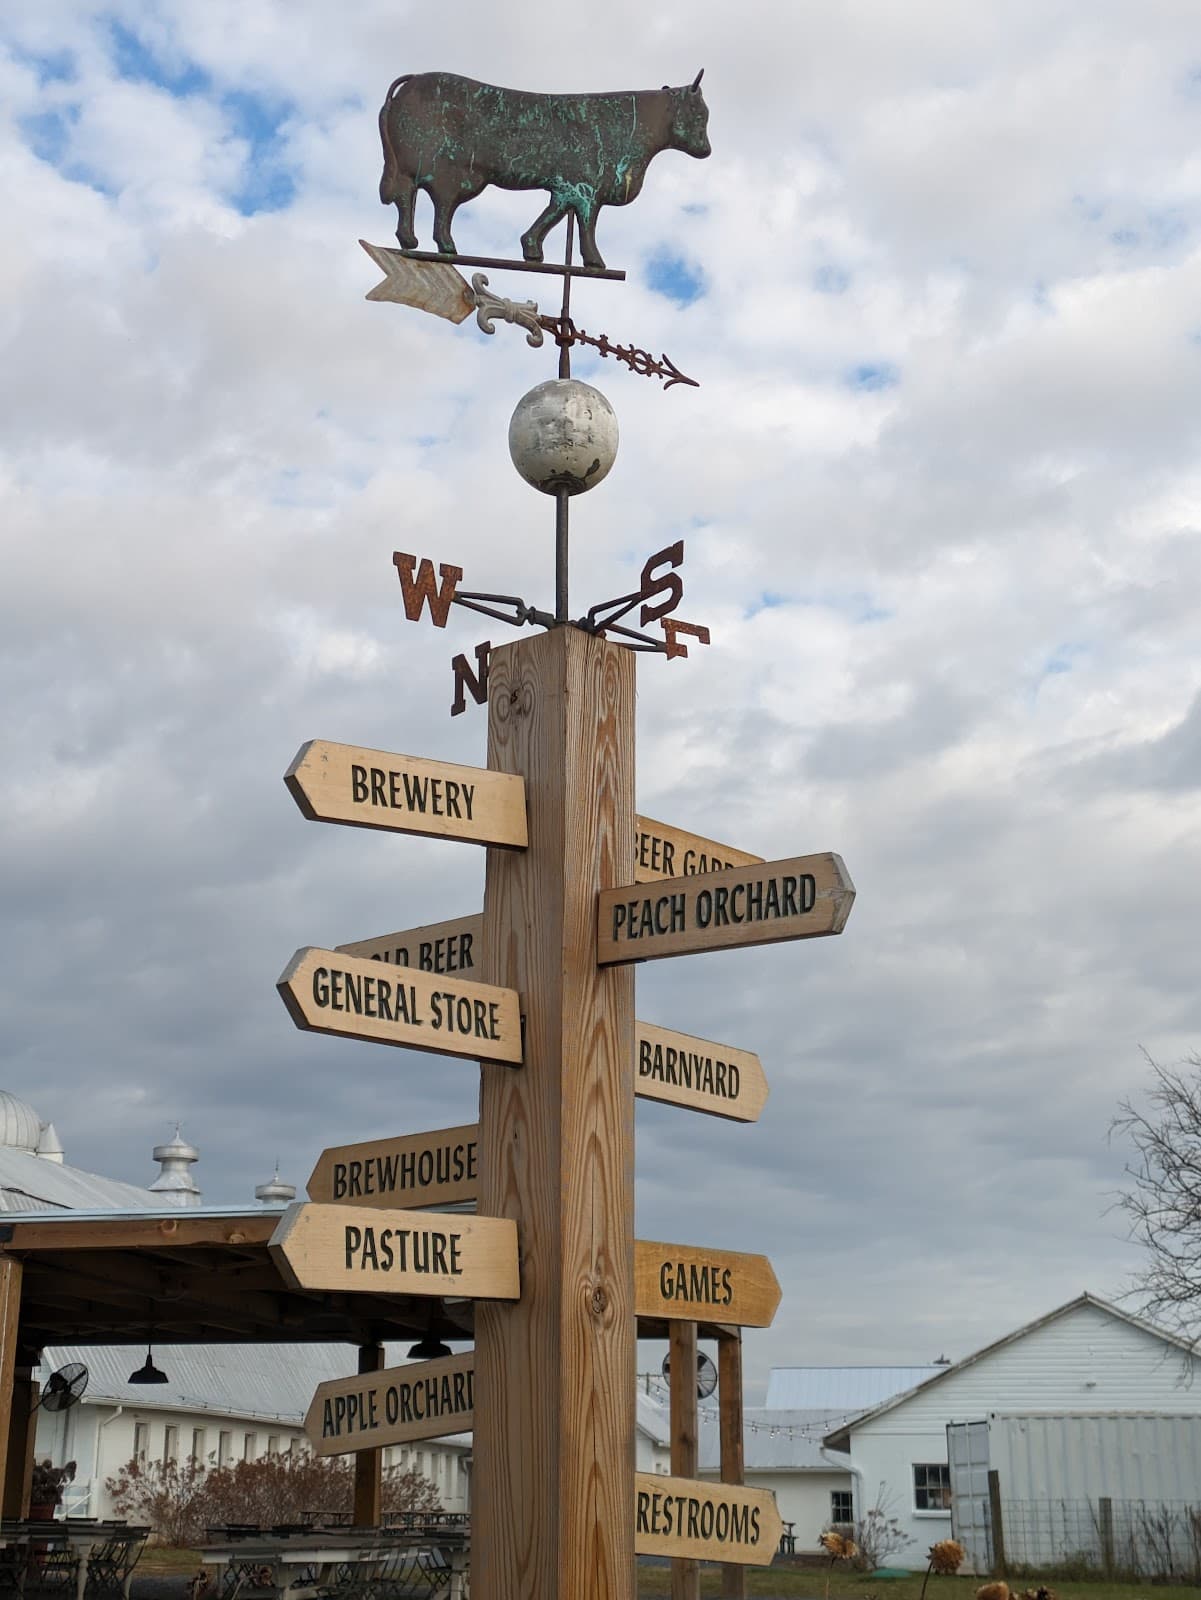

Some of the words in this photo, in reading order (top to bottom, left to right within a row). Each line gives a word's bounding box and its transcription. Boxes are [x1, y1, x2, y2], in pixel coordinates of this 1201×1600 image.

[393, 551, 463, 628] W
[640, 540, 684, 628] S
[451, 641, 490, 717] N
[351, 764, 475, 821] BREWERY
[612, 893, 687, 942] PEACH
[696, 873, 817, 930] ORCHARD
[419, 933, 474, 974] BEER
[312, 966, 423, 1026] GENERAL
[430, 991, 501, 1041] STORE
[639, 1039, 740, 1100] BARNYARD
[333, 1142, 478, 1201] BREWHOUSE
[345, 1225, 463, 1275] PASTURE
[660, 1261, 733, 1306] GAMES
[322, 1390, 379, 1438] APPLE
[636, 1491, 761, 1545] RESTROOMS
